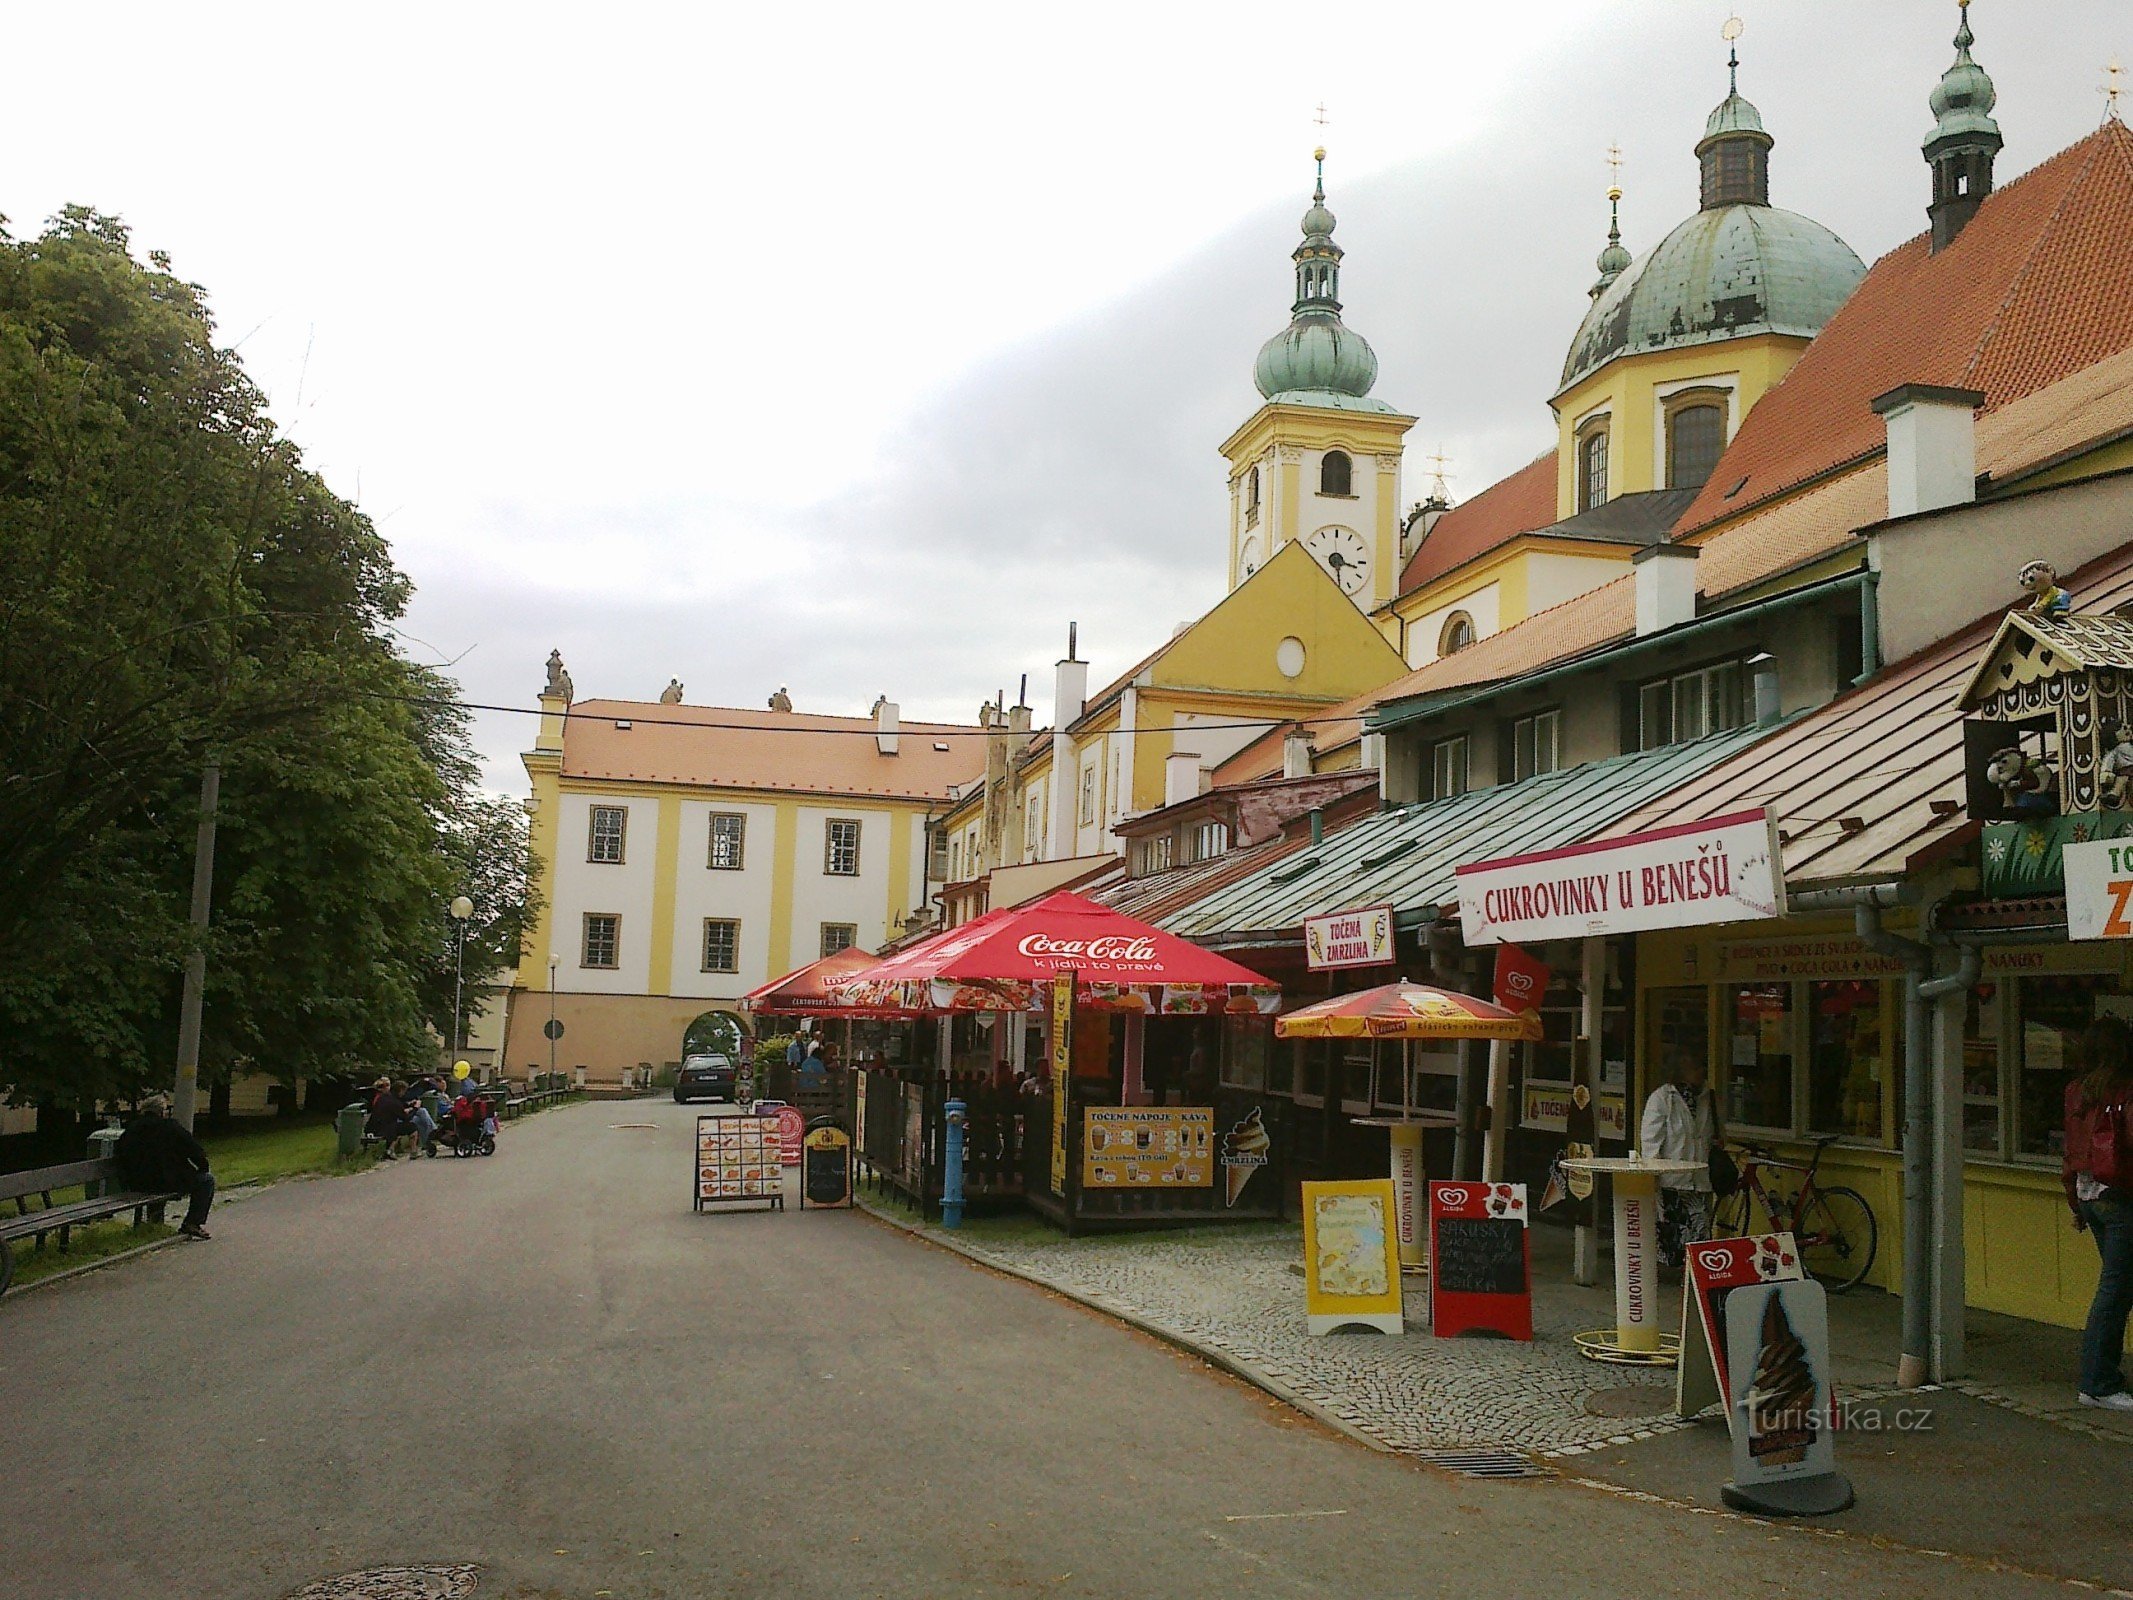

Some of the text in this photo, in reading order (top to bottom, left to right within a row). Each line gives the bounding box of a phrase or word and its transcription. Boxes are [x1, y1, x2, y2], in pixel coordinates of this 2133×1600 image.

[1485, 873, 1609, 924] CUKROVINKY
[1617, 871, 1633, 909] U
[1641, 840, 1730, 906] BENEŠŮ
[1330, 917, 1361, 941] TOČENÁ
[1018, 933, 1157, 960] Coca-Cola
[1326, 941, 1369, 962] ZMRZLINA
[1091, 961, 1111, 970] to
[1628, 1254, 1643, 1323] CUKROVINKY
